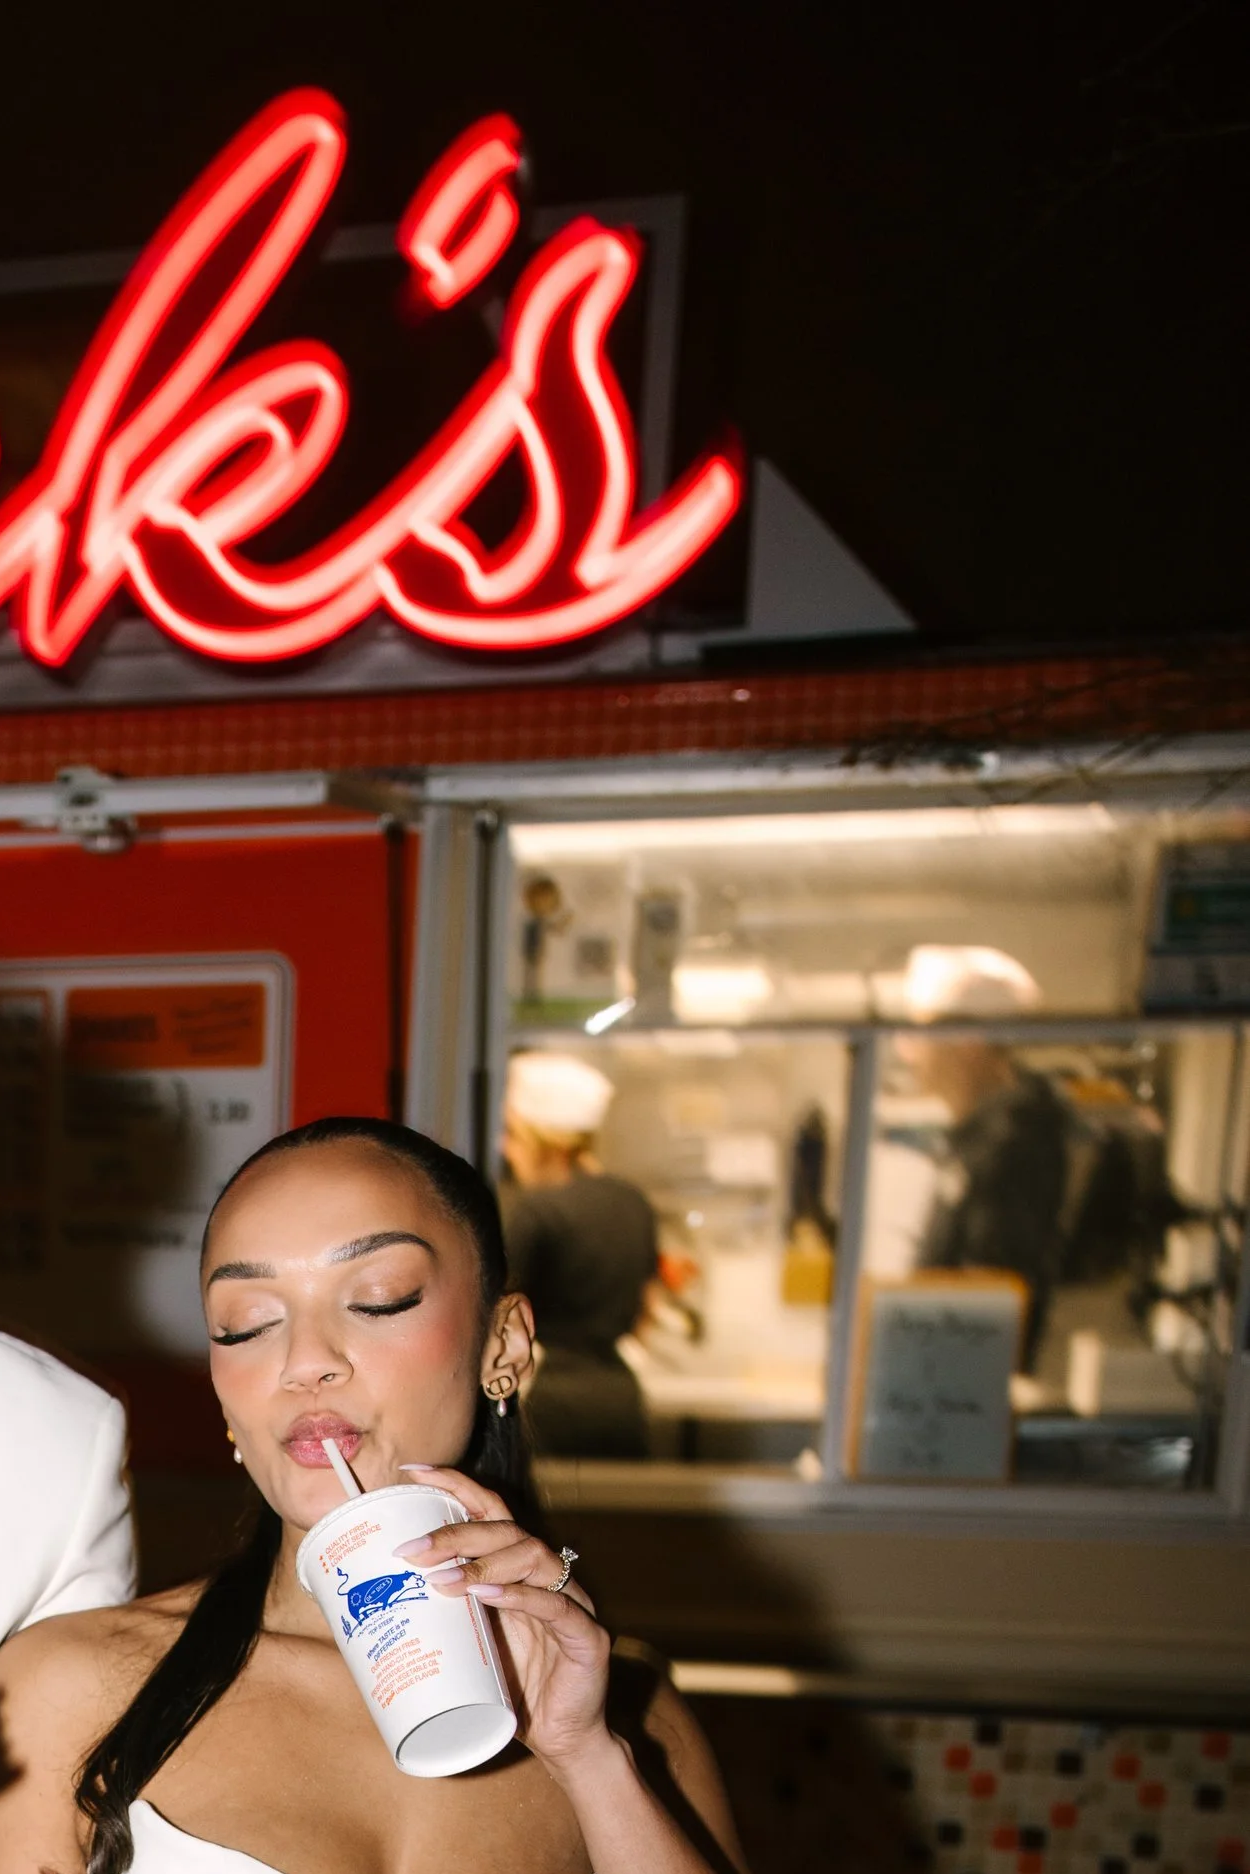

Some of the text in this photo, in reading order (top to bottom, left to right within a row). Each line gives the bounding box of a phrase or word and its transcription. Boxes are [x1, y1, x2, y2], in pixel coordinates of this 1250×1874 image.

[325, 1521, 369, 1555] QUALITY FIRST
[328, 1524, 382, 1561] INSTANT SERVICE
[331, 1539, 367, 1567] LOW PRICES
[366, 1642, 380, 1660] Where
[378, 1627, 395, 1643] TASTE
[400, 1617, 410, 1627] the
[373, 1628, 407, 1662] DIFFERENCE!
[379, 1647, 401, 1664] FRENCH
[401, 1637, 421, 1650] FRIES
[380, 1664, 406, 1685] POTATOES
[406, 1658, 417, 1668] and
[416, 1651, 436, 1663] cooked
[395, 1662, 428, 1682] VEGETABLE
[395, 1678, 415, 1695] UNIQUE
